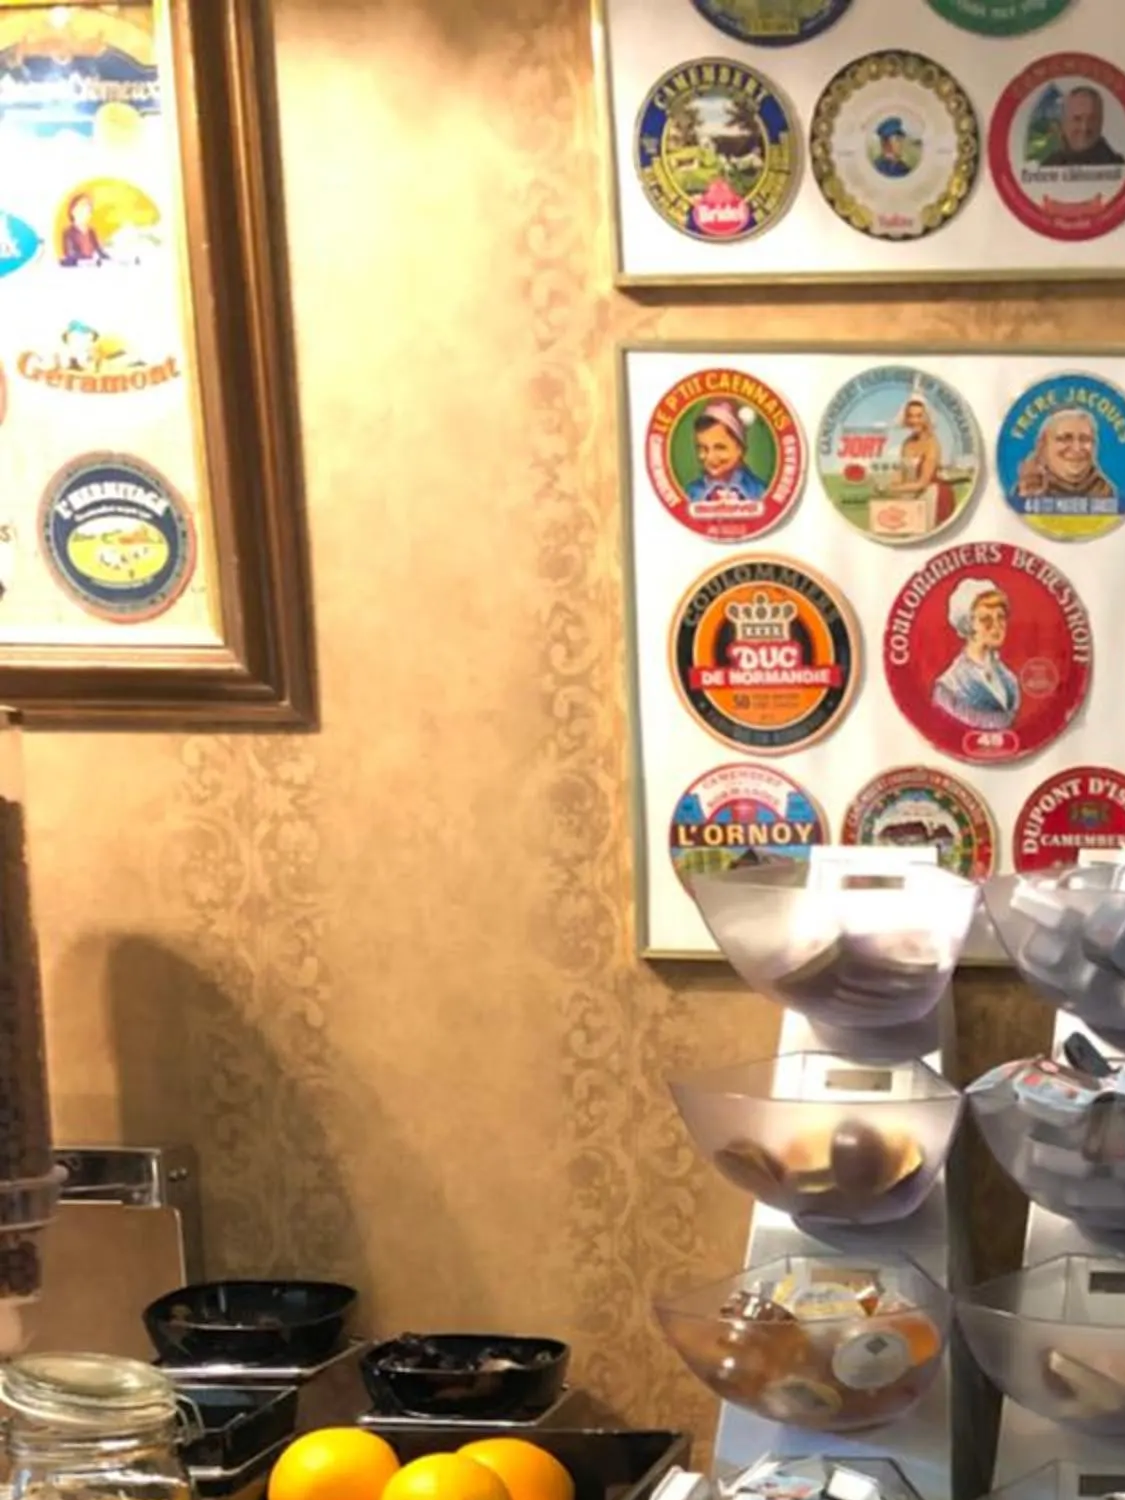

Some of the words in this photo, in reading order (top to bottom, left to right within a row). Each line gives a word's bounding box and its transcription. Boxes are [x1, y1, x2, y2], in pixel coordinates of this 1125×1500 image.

[837, 434, 888, 459] JORT
[684, 564, 840, 627] COULOMMIERS
[889, 544, 1002, 666] COULOMMIERS
[732, 645, 799, 669] DUC
[701, 669, 725, 686] DE
[729, 668, 831, 685] NORMANDIE
[1022, 778, 1083, 855] DUPONT
[677, 822, 814, 846] L'ORNOY
